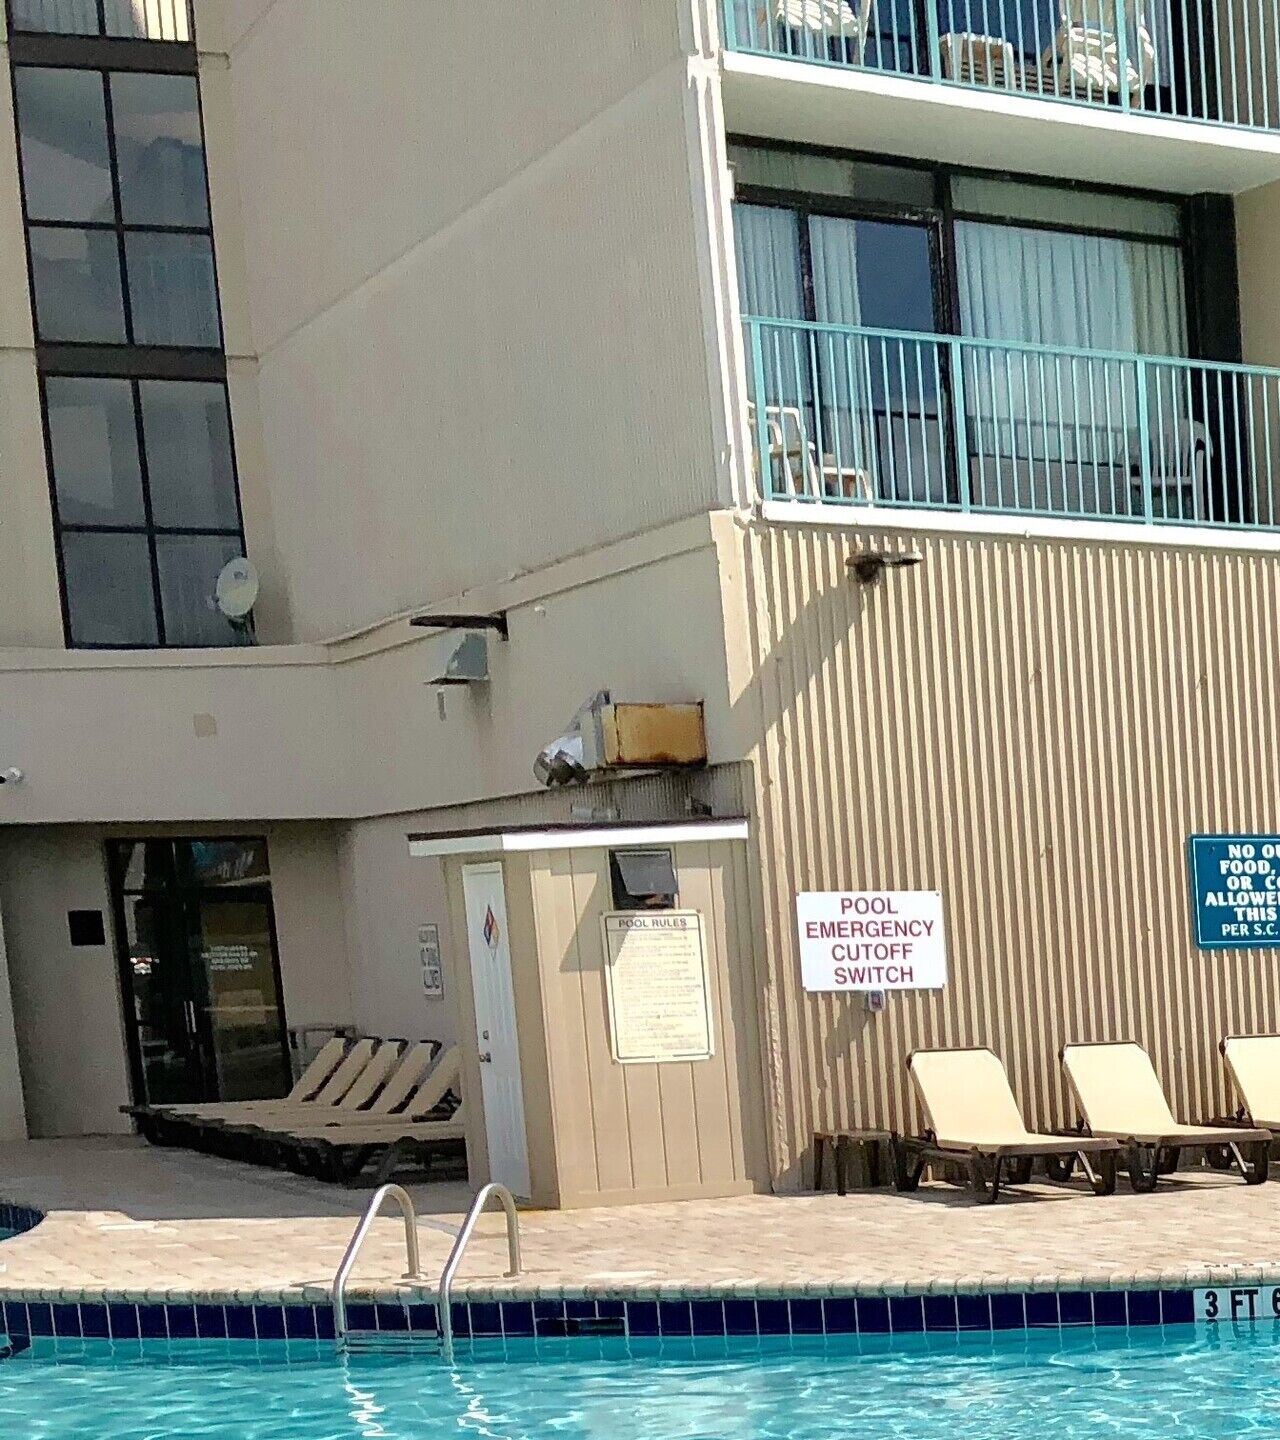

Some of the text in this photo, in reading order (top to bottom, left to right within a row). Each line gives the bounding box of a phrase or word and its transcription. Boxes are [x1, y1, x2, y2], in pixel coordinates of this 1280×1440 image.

[1227, 844, 1256, 859] NO
[1219, 859, 1276, 875] FOOD,
[1226, 875, 1253, 890] OR
[840, 897, 899, 915] POOL
[1233, 906, 1277, 922] THIS
[618, 917, 688, 928] POOL RULES
[805, 920, 934, 939] EMERGENCY
[1221, 924, 1250, 937] PER
[1253, 923, 1279, 936] S.C.
[831, 943, 913, 962] CUTOFF
[834, 966, 914, 985] SWITCH
[1204, 1290, 1219, 1318] 3
[1230, 1289, 1259, 1319] FT
